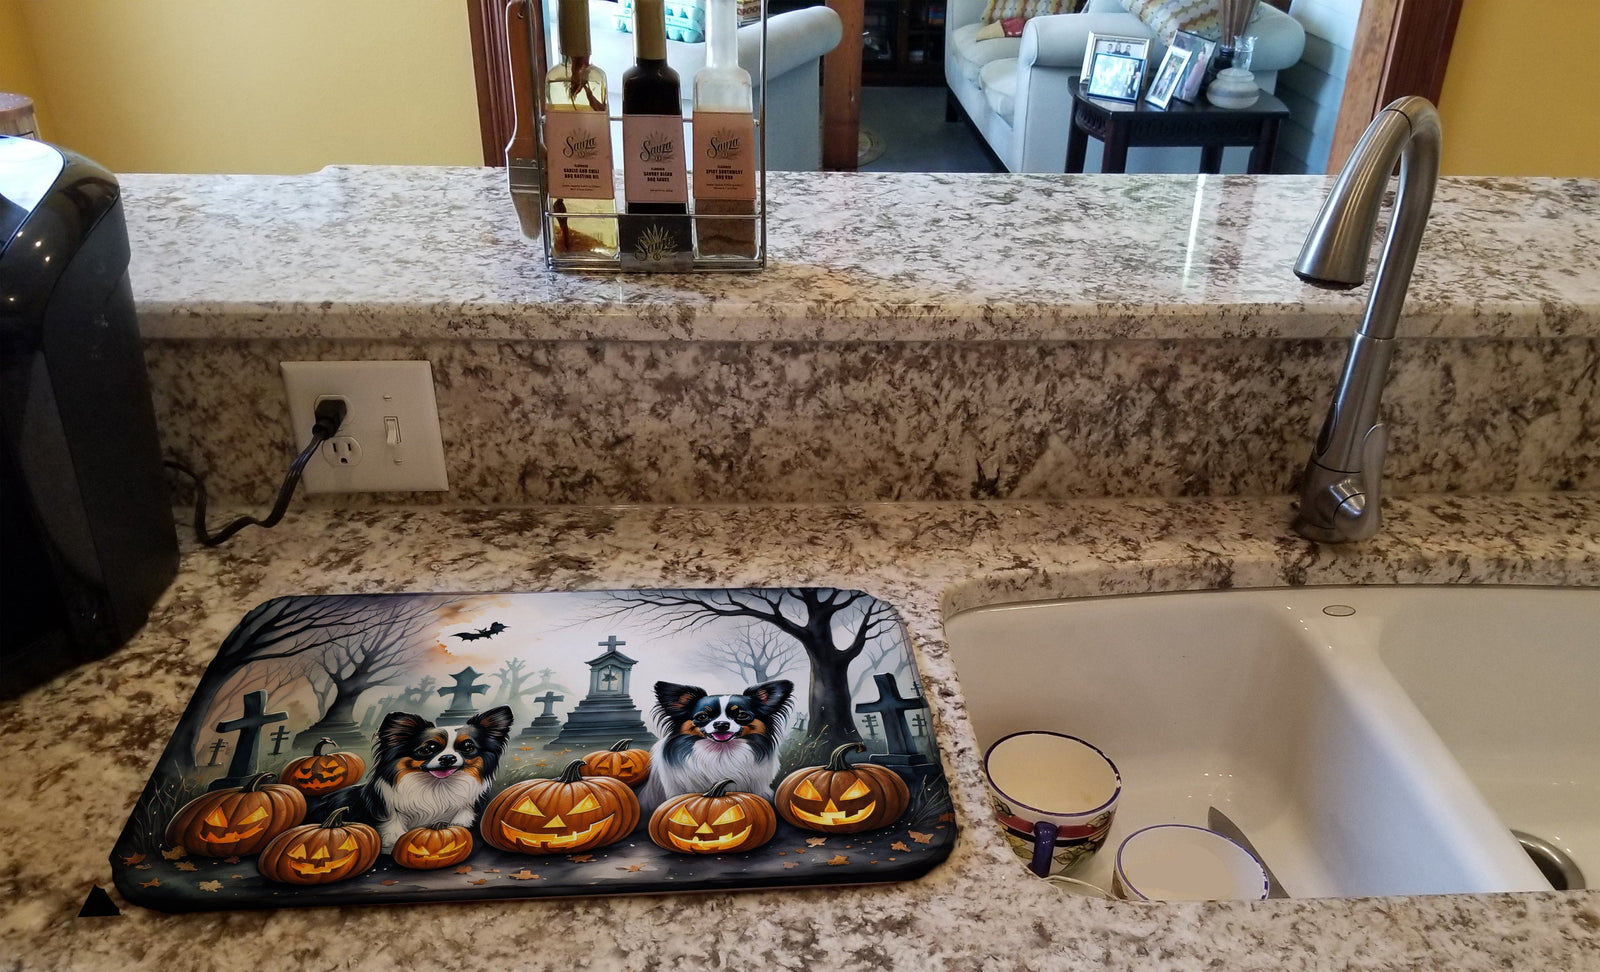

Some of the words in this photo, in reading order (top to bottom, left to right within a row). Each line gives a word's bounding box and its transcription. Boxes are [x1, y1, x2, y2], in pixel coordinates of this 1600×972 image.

[563, 136, 598, 158] Sauza
[640, 140, 674, 162] Sauza
[707, 137, 741, 159] Sauza
